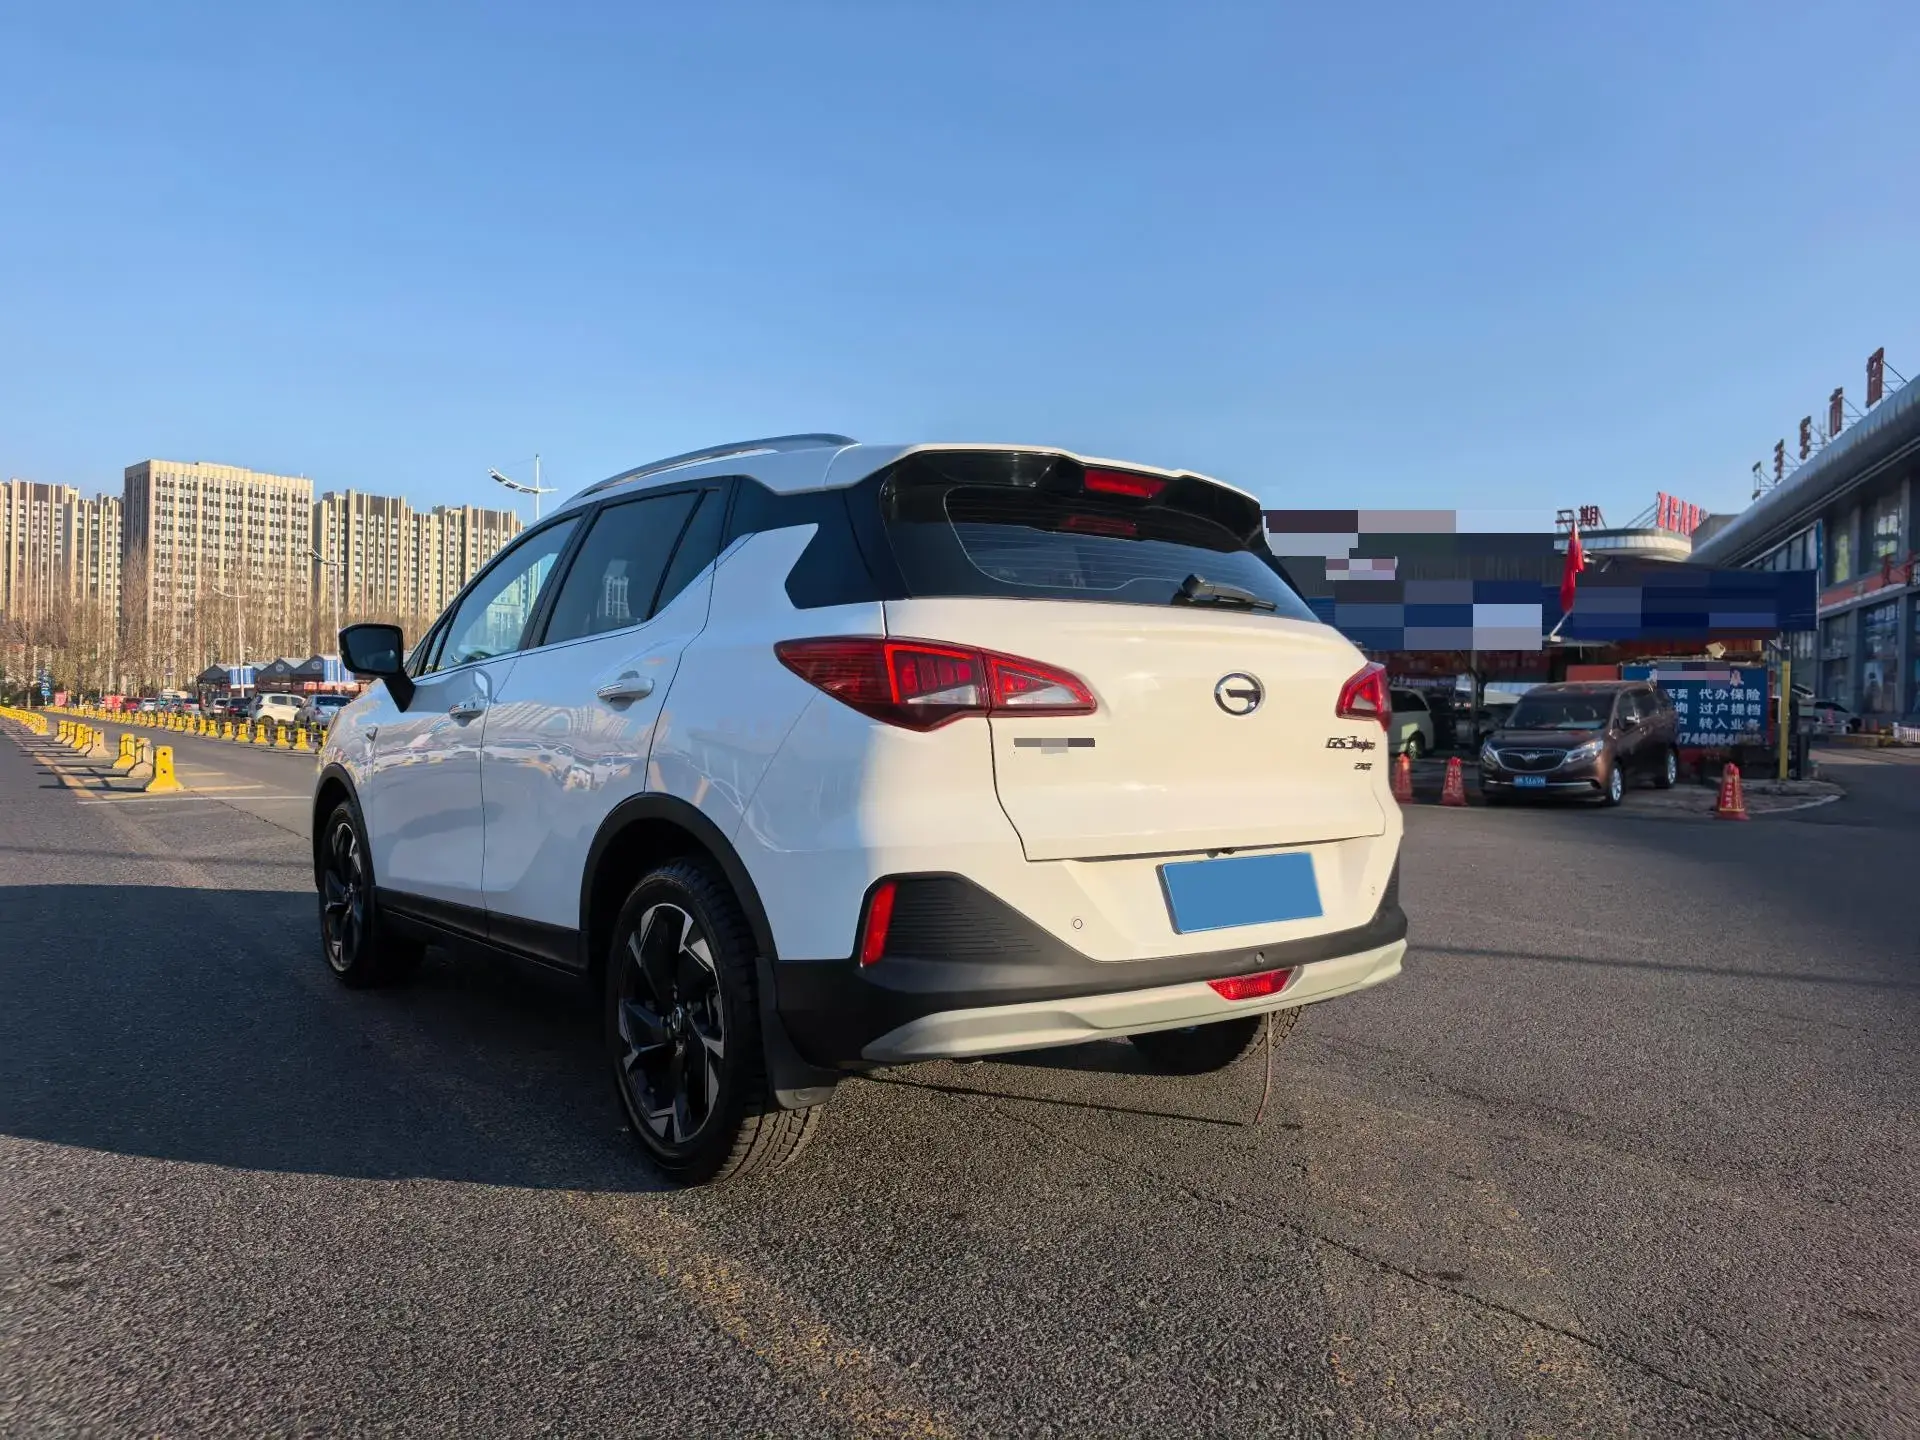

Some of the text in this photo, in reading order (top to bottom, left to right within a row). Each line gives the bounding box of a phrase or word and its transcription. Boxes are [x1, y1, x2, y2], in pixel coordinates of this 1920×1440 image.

[1555, 505, 1600, 527] 二期
[1699, 688, 1761, 701] 代办保险
